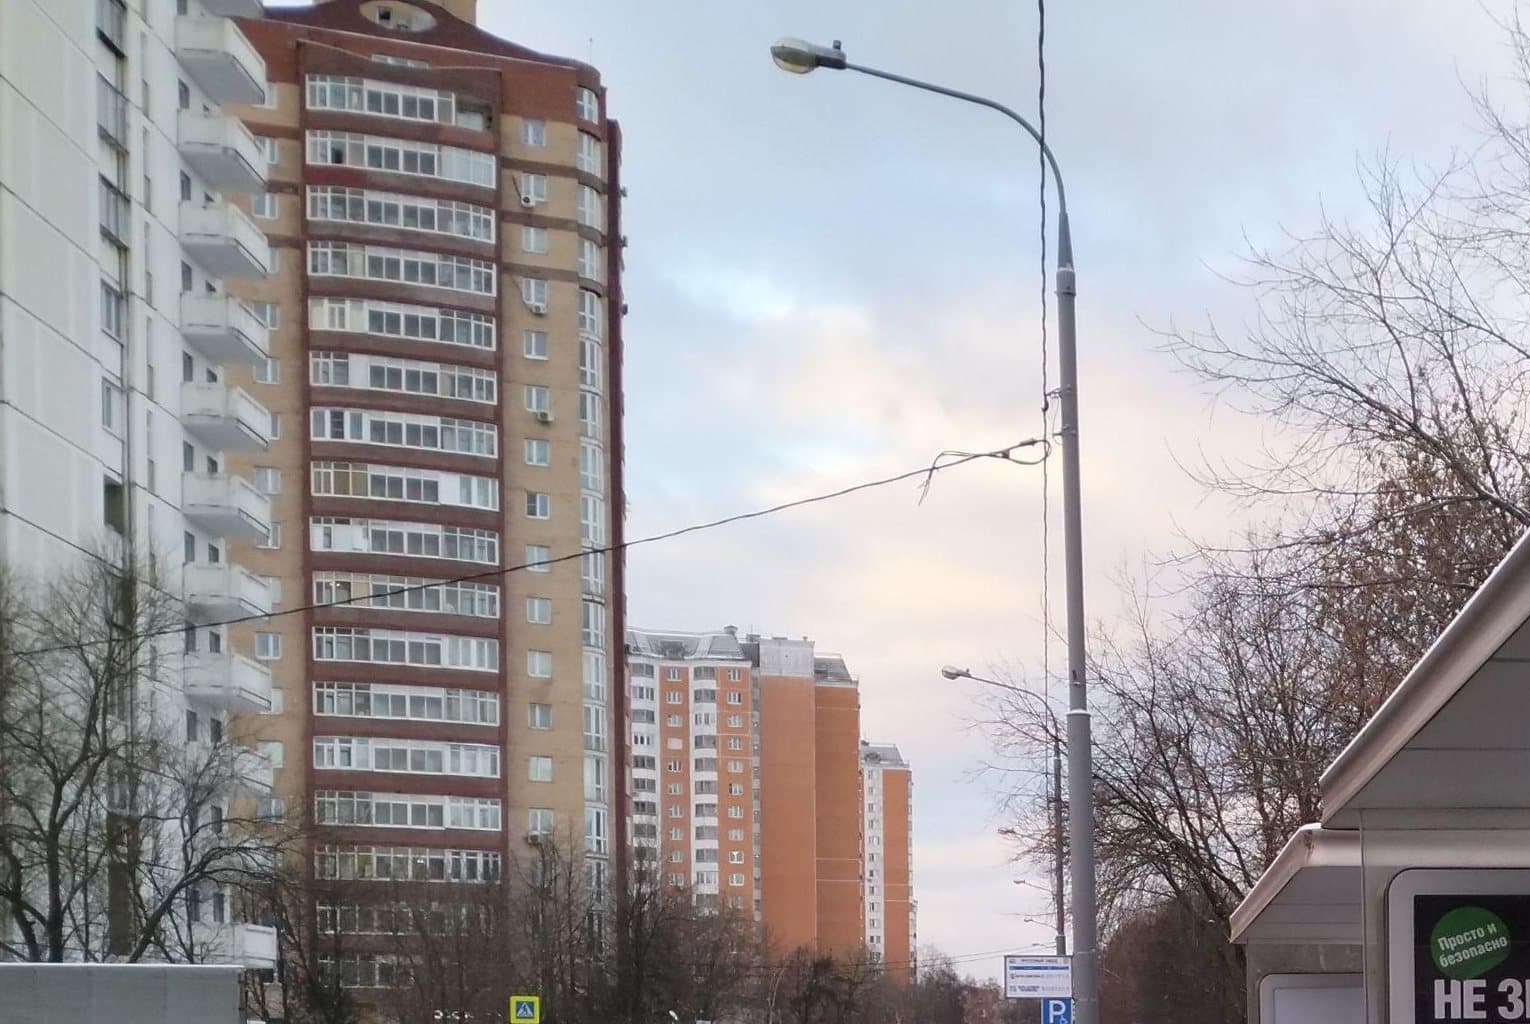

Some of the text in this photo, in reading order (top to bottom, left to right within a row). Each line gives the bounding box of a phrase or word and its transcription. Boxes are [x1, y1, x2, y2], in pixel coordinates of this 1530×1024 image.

[1438, 923, 1497, 951] Просто и
[1439, 936, 1508, 967] безопасно
[1049, 999, 1066, 1024] P
[1434, 979, 1488, 1019] НЕ
